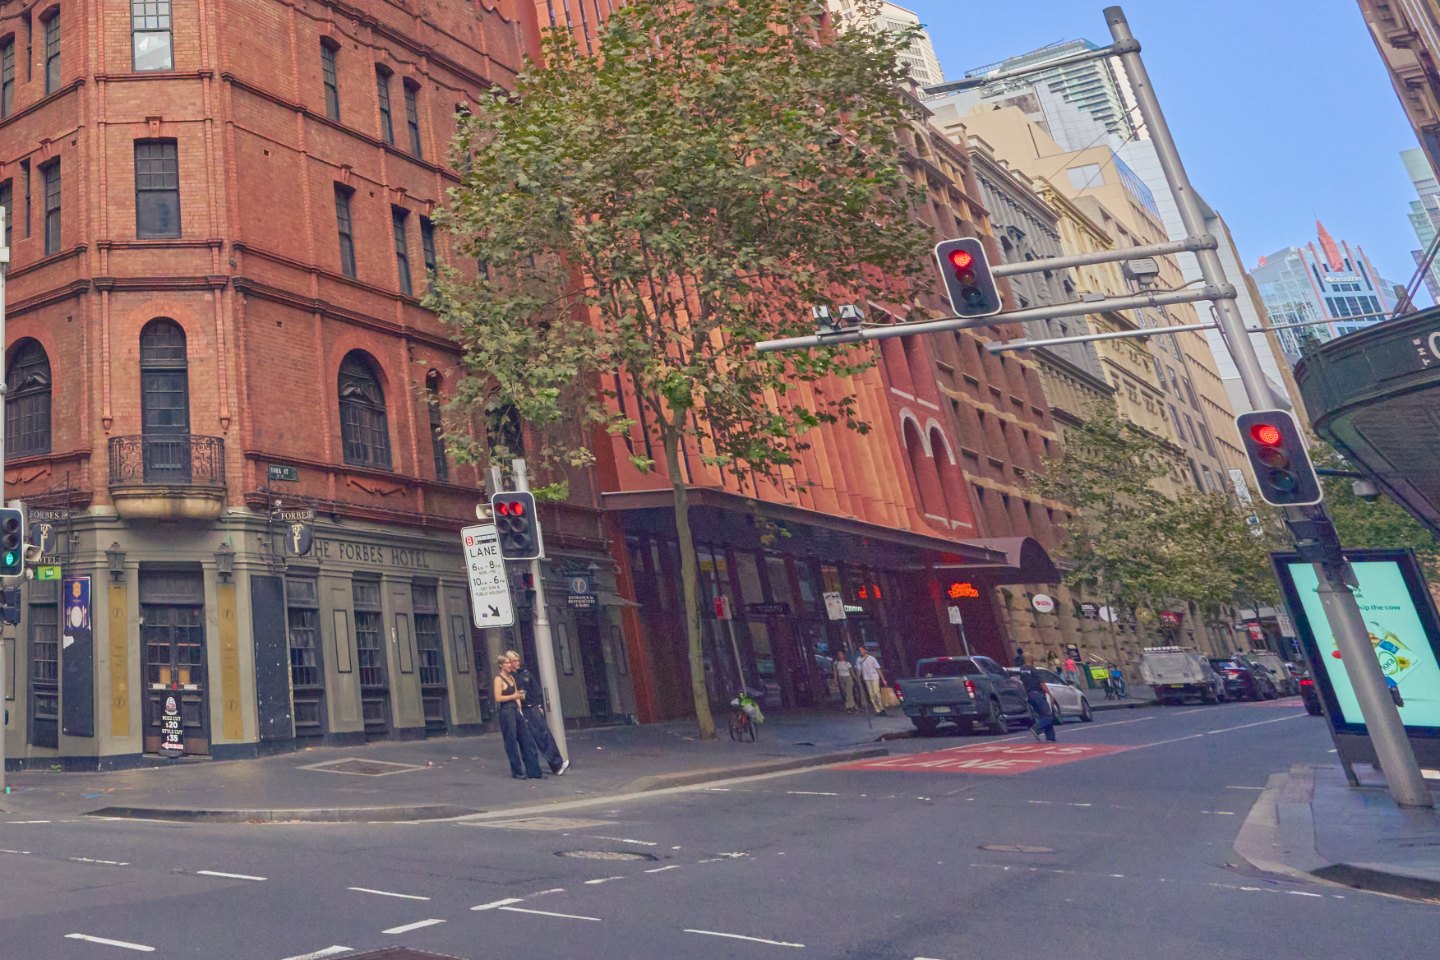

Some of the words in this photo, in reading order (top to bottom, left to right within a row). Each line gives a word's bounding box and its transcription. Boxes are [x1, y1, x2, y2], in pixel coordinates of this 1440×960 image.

[29, 509, 60, 520] FORBES
[281, 510, 312, 520] FORBES
[310, 541, 330, 559] HE
[339, 543, 384, 564] FORBES
[391, 549, 430, 569] HOTEL
[470, 545, 497, 558] LANE
[165, 721, 178, 729] $20
[166, 734, 179, 742] $35
[957, 745, 1093, 756] BUS
[865, 757, 1044, 770] LANE
